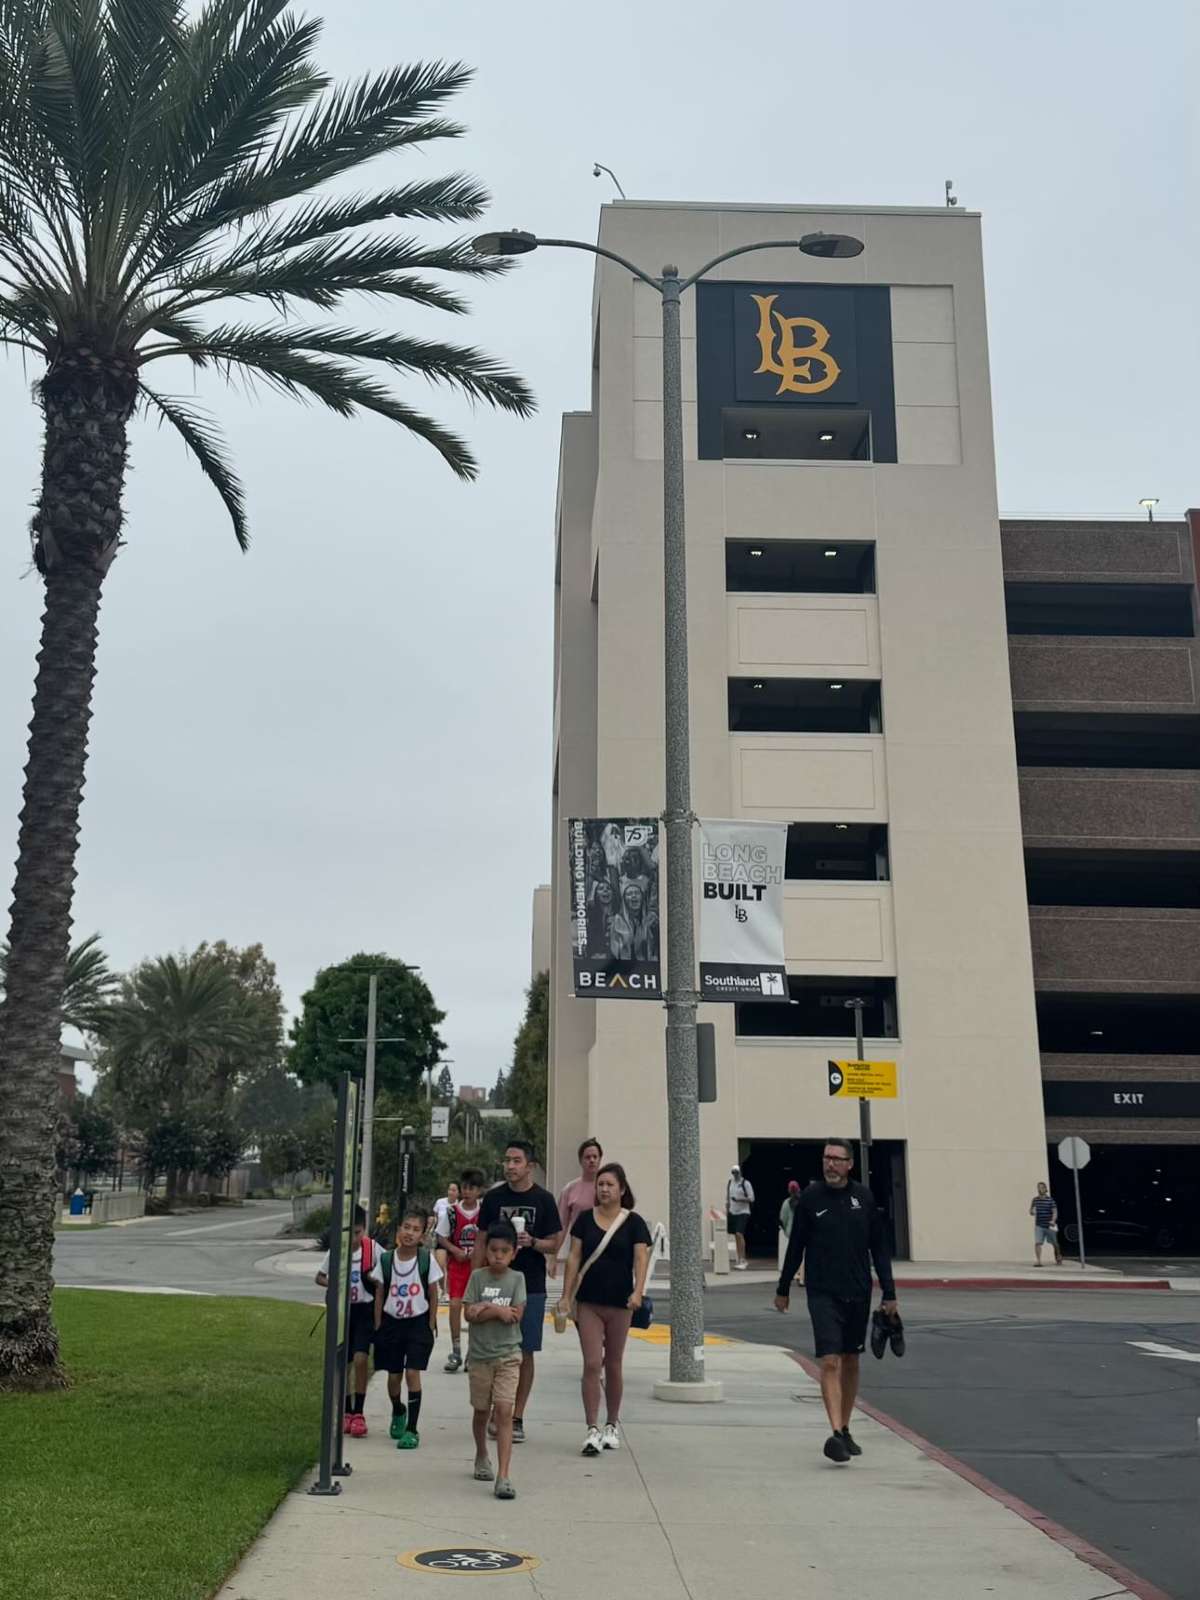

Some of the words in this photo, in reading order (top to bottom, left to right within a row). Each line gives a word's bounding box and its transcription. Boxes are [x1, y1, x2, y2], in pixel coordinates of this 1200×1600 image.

[574, 821, 585, 880] BUILDING
[703, 842, 768, 863] LONG
[703, 862, 783, 885] BEACH
[704, 882, 767, 901] BUILT
[579, 971, 657, 989] BEACH
[704, 974, 760, 986] Southland
[1113, 1093, 1144, 1104] EXIT
